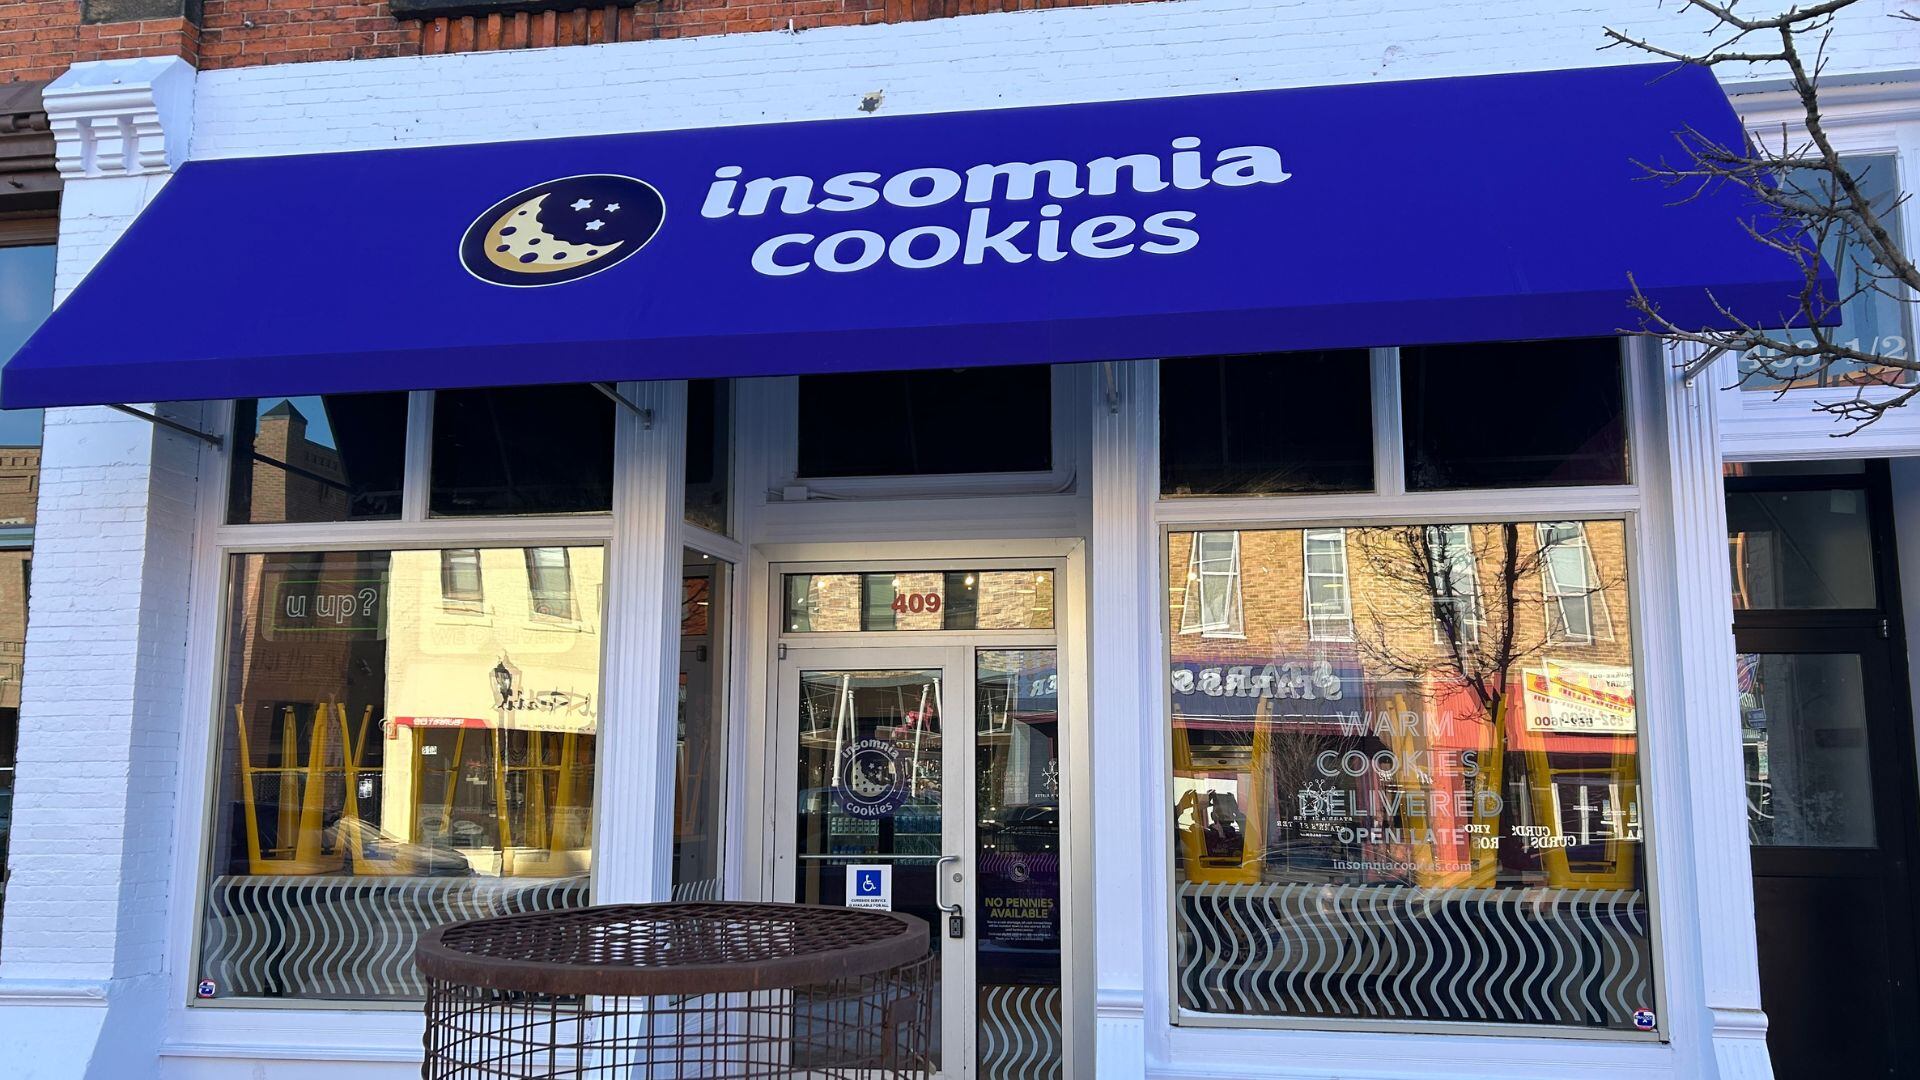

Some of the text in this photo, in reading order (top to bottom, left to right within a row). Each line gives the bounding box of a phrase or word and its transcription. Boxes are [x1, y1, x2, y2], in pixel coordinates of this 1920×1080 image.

[701, 136, 1292, 219] insomnia
[751, 204, 1200, 276] cookies
[286, 588, 377, 624] u up?
[892, 593, 941, 613] 409
[1336, 710, 1455, 737] WARM
[840, 739, 900, 760] insomnia
[1316, 749, 1480, 778] COOKIES
[846, 802, 893, 816] cookies
[1300, 789, 1504, 818] DELIVERED
[1337, 827, 1465, 845] OPEN LATE
[1333, 859, 1473, 872] insomniacookies.com
[984, 897, 1054, 908] NO PENNIES
[990, 908, 1048, 918] AVAILABLE
